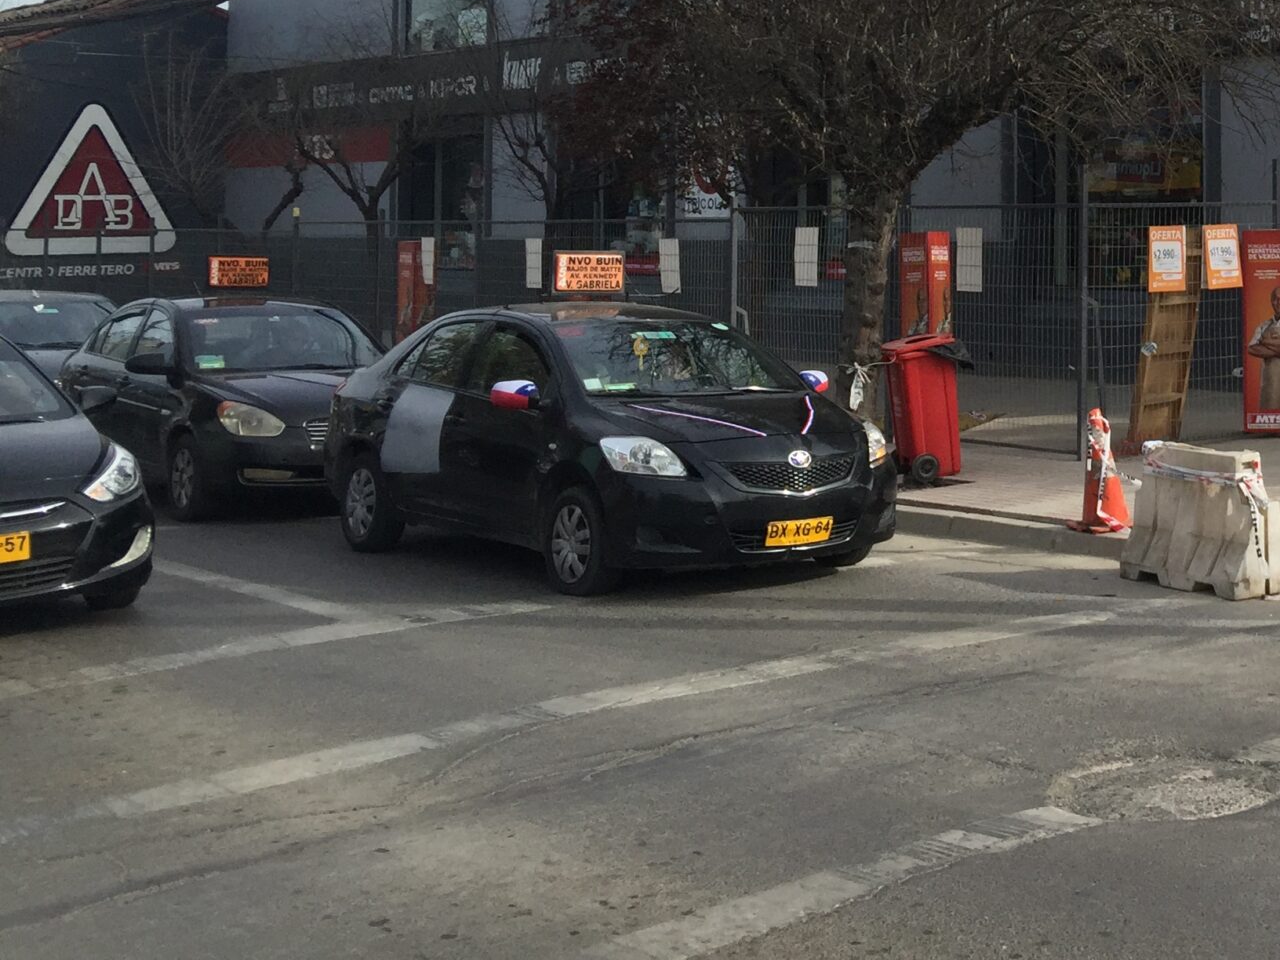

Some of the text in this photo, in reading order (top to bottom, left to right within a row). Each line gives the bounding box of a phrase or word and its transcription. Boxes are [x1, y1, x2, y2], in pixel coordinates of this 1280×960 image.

[1151, 230, 1182, 240] OFERTA
[1206, 228, 1237, 239] OFERTA
[568, 256, 592, 266] NVO
[596, 256, 623, 266] BUIN
[58, 263, 135, 277] FERRETERO
[577, 280, 621, 289] GABRIELA
